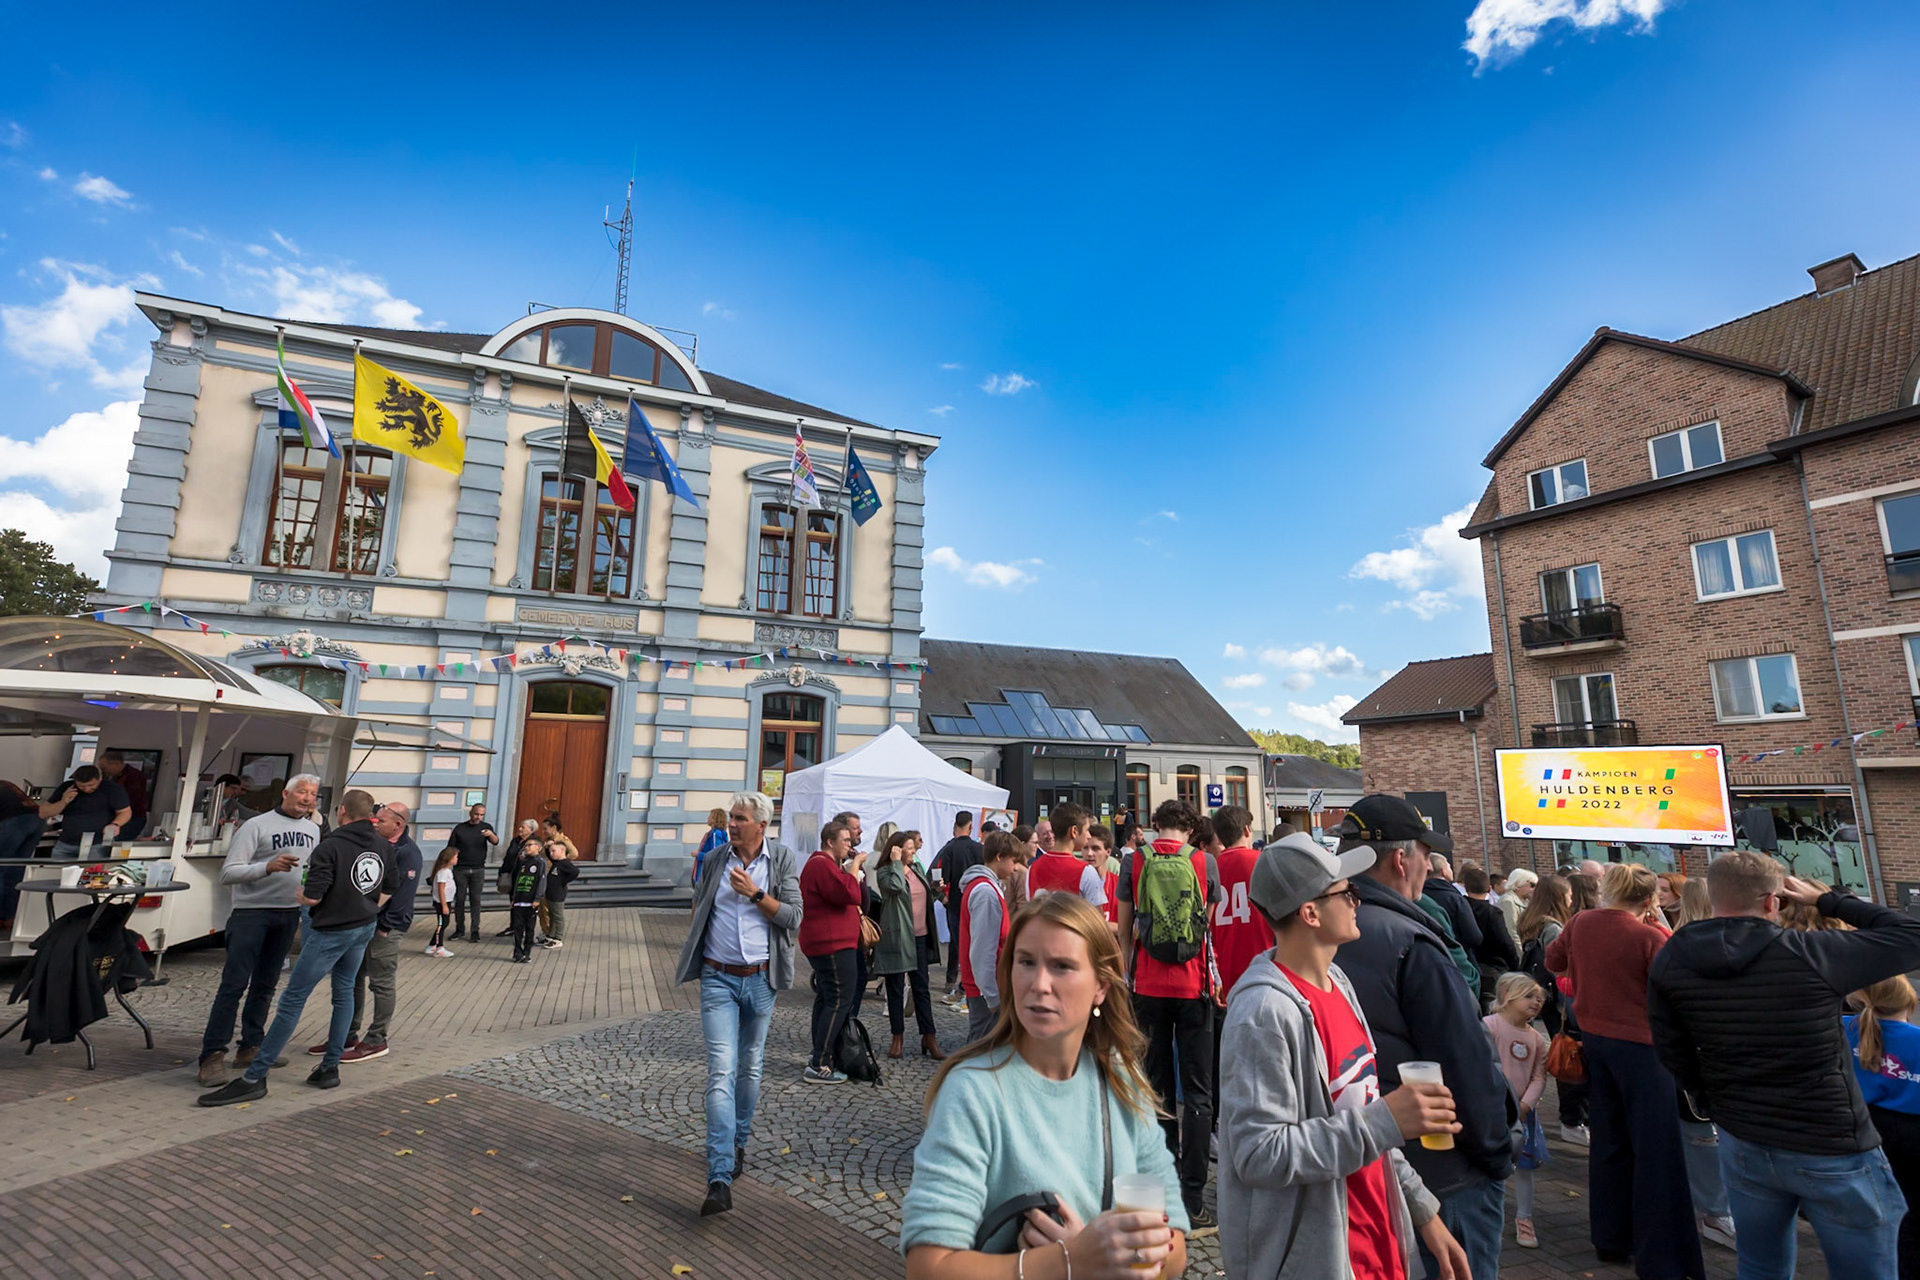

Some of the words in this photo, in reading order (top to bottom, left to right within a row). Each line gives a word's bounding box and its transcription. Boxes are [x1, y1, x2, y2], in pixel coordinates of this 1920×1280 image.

[518, 608, 595, 626] GEMEENTE
[604, 616, 635, 631] HUIS
[1577, 770, 1637, 778] KAMPIOEN
[1540, 785, 1674, 795] HULDENBERG
[1581, 800, 1621, 809] 2022
[1215, 881, 1251, 926] 24
